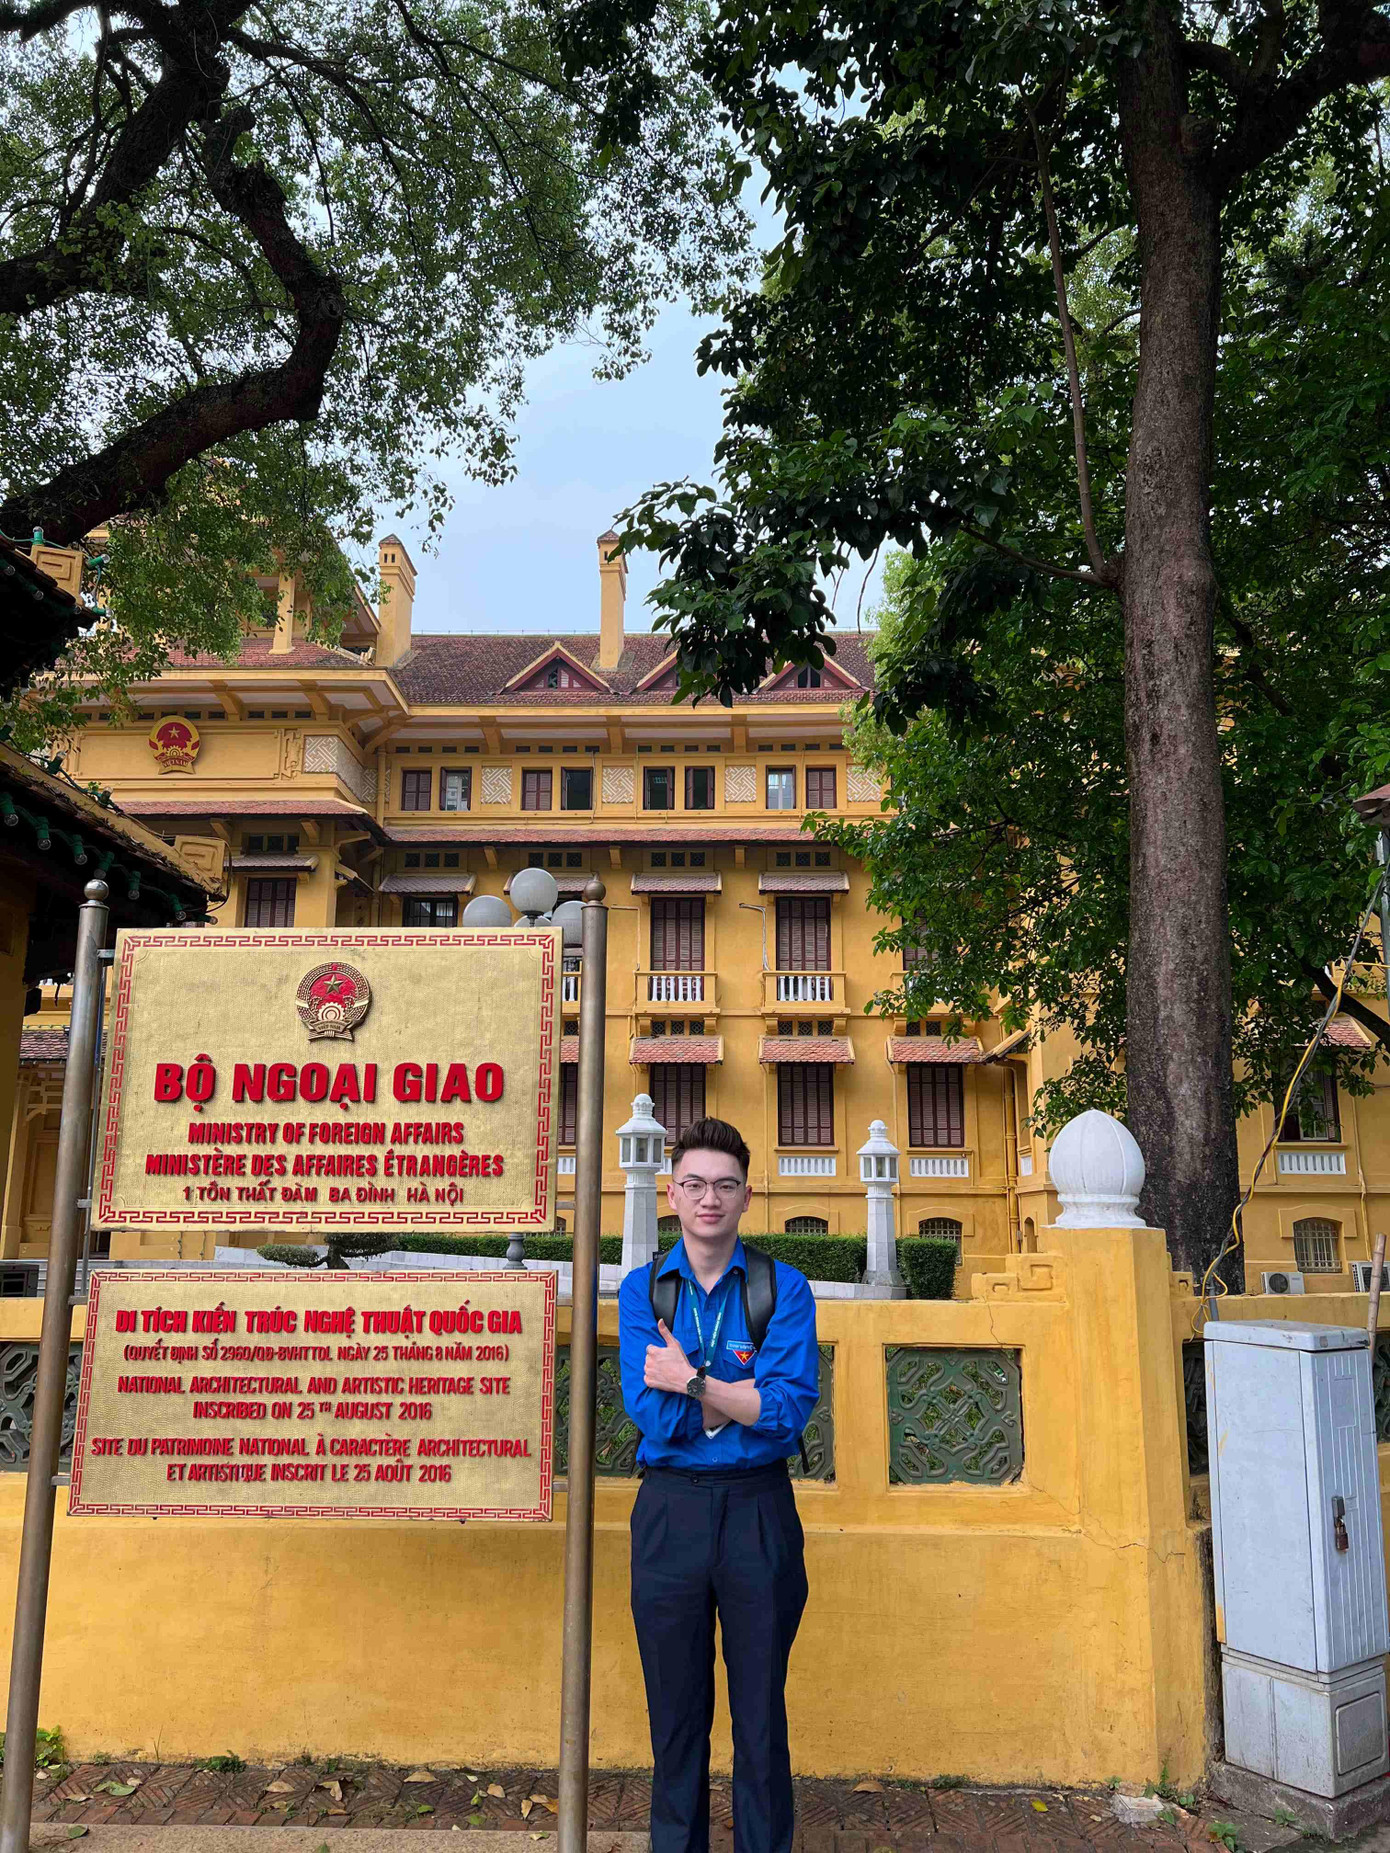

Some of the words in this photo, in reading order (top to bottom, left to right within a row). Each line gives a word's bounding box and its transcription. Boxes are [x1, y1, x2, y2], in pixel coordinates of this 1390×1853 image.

[154, 1052, 216, 1113] BỘ
[232, 1062, 376, 1111] NGOẠI
[393, 1062, 504, 1103] GIAO
[188, 1121, 278, 1145] MINISTRY
[282, 1122, 306, 1144] OF
[308, 1121, 385, 1145] FOREIGN
[391, 1121, 464, 1145] AFFAIRS
[145, 1147, 246, 1176] MINISTÈRE
[251, 1154, 287, 1176] DES
[291, 1154, 377, 1177] AFFAIRES
[383, 1147, 504, 1177] ÉTRANGÈRES
[182, 1186, 191, 1202] 1
[196, 1180, 230, 1202] TÔN
[235, 1179, 277, 1202] THẤT
[280, 1181, 316, 1203] ĐÀM
[328, 1186, 352, 1202] BA
[355, 1181, 394, 1203] ĐÌNH
[406, 1181, 430, 1203] HÀ
[434, 1181, 464, 1206] NỘI
[115, 1309, 137, 1333] DI
[141, 1306, 187, 1334] TÍCH
[191, 1301, 236, 1334] KIẾN
[244, 1304, 298, 1334] TRÚC
[303, 1306, 356, 1339] NGHỆ
[360, 1304, 426, 1339] THUẬT
[428, 1299, 485, 1337] QUỐC
[486, 1309, 522, 1335] GIA
[123, 1338, 170, 1361] (QUYẾT
[170, 1345, 199, 1363] ĐỊNH
[201, 1338, 220, 1360] SỐ
[337, 1342, 371, 1361] NGÀY
[372, 1345, 389, 1361] 25
[392, 1341, 433, 1361] THÁNG
[435, 1345, 443, 1361] 8
[444, 1339, 473, 1361] NĂM
[475, 1344, 510, 1361] 2016)
[117, 1375, 185, 1396] NATIONAL
[189, 1375, 303, 1396] ARCHITECTURAL
[306, 1376, 338, 1395] AND
[340, 1376, 405, 1396] ARTISTIC
[407, 1375, 475, 1396] HERITAGE
[479, 1376, 511, 1396] SITE
[192, 1400, 267, 1420] INSCRIBED
[270, 1400, 292, 1419] ON
[296, 1400, 315, 1420] 25
[334, 1400, 393, 1420] AUGUST
[397, 1400, 432, 1420] 2016
[90, 1436, 124, 1456] SITE
[126, 1437, 148, 1456] DU
[150, 1437, 235, 1456] PATRIMOINE
[238, 1437, 310, 1456] NATIONAL
[315, 1432, 326, 1456] À
[329, 1432, 411, 1457] CARACTÈRE
[416, 1438, 532, 1458] ARCHITECTURAL
[166, 1463, 185, 1482] ET
[187, 1462, 266, 1482] ARTISTIQUE
[270, 1461, 328, 1483] INSCRIT
[331, 1463, 350, 1483] LE
[352, 1463, 371, 1482] 25
[373, 1457, 413, 1483] AOÛT
[418, 1463, 452, 1484] 2016
